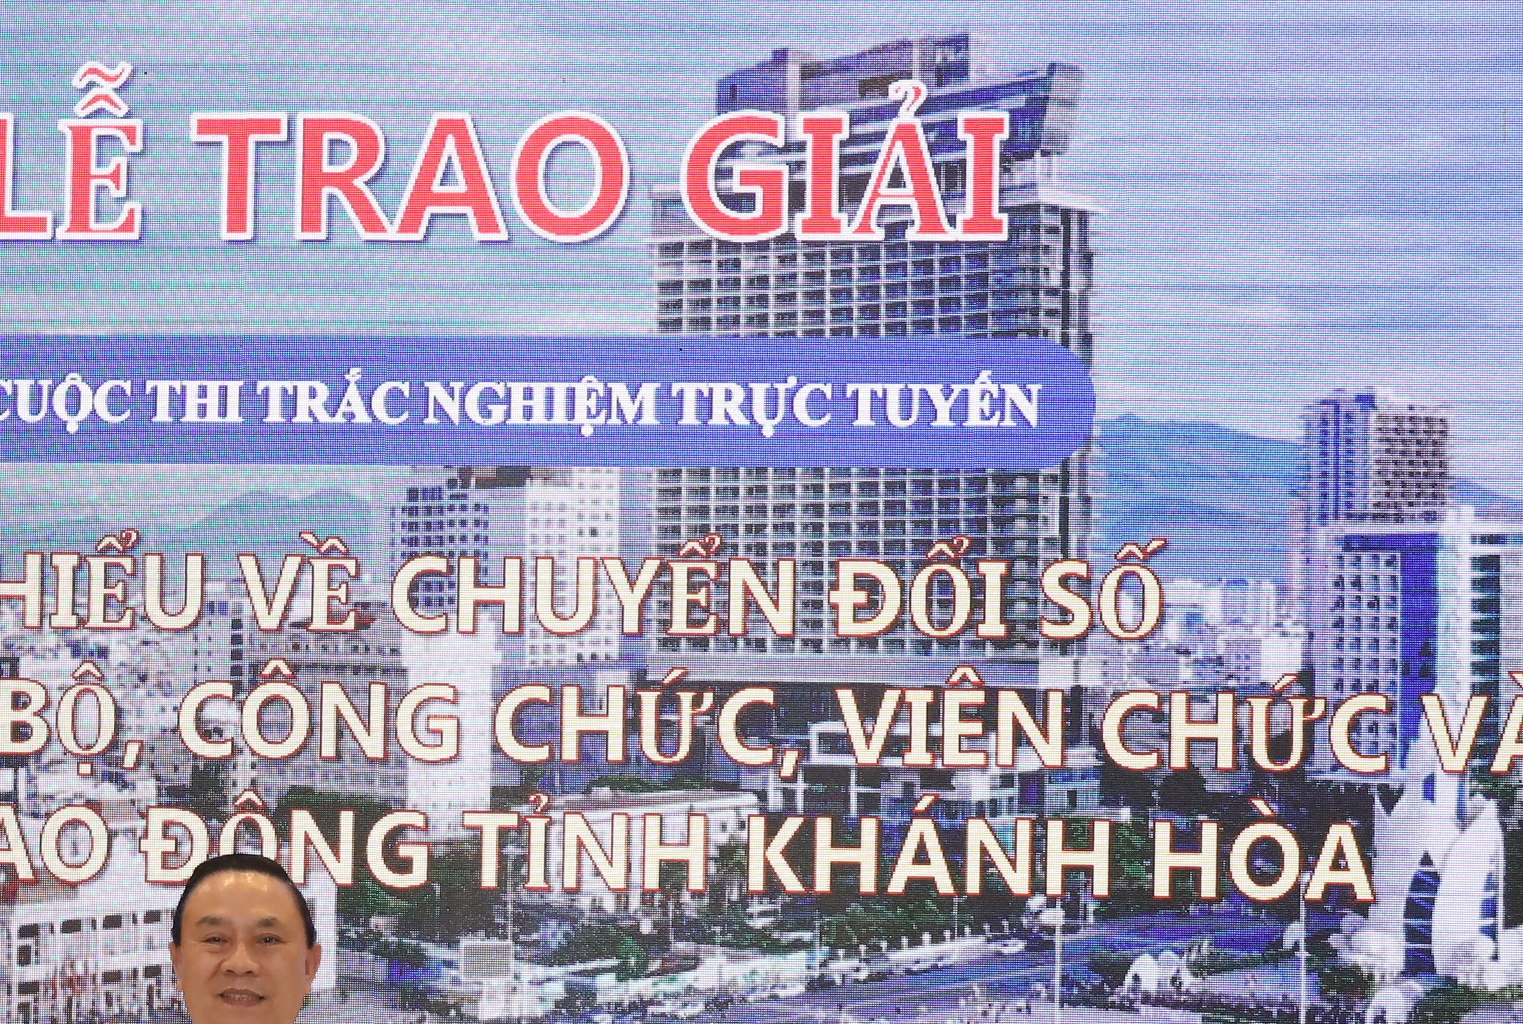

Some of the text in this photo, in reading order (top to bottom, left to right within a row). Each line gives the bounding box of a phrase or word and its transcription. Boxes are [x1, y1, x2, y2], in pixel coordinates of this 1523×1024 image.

[189, 109, 631, 244] TRAO
[679, 79, 1010, 244] GIẢI
[145, 378, 245, 425] THI
[255, 368, 412, 426] TRẮC
[423, 375, 661, 438] NGHIỆM
[670, 375, 834, 439] TRỰC
[844, 369, 1044, 429] TUYẾN
[238, 530, 361, 633] VỀ
[390, 534, 796, 637] CHUYỂN
[829, 534, 1012, 639] ĐỔI
[1038, 538, 1166, 641] SỐ
[178, 658, 462, 764] CÔNG
[493, 666, 803, 780] CHỨC,
[835, 664, 1066, 769] VIÊN
[1101, 673, 1392, 774] CHỨC
[461, 793, 709, 893] TỈNH
[746, 793, 1114, 898] KHÁNH
[1153, 796, 1378, 904] HÒA
